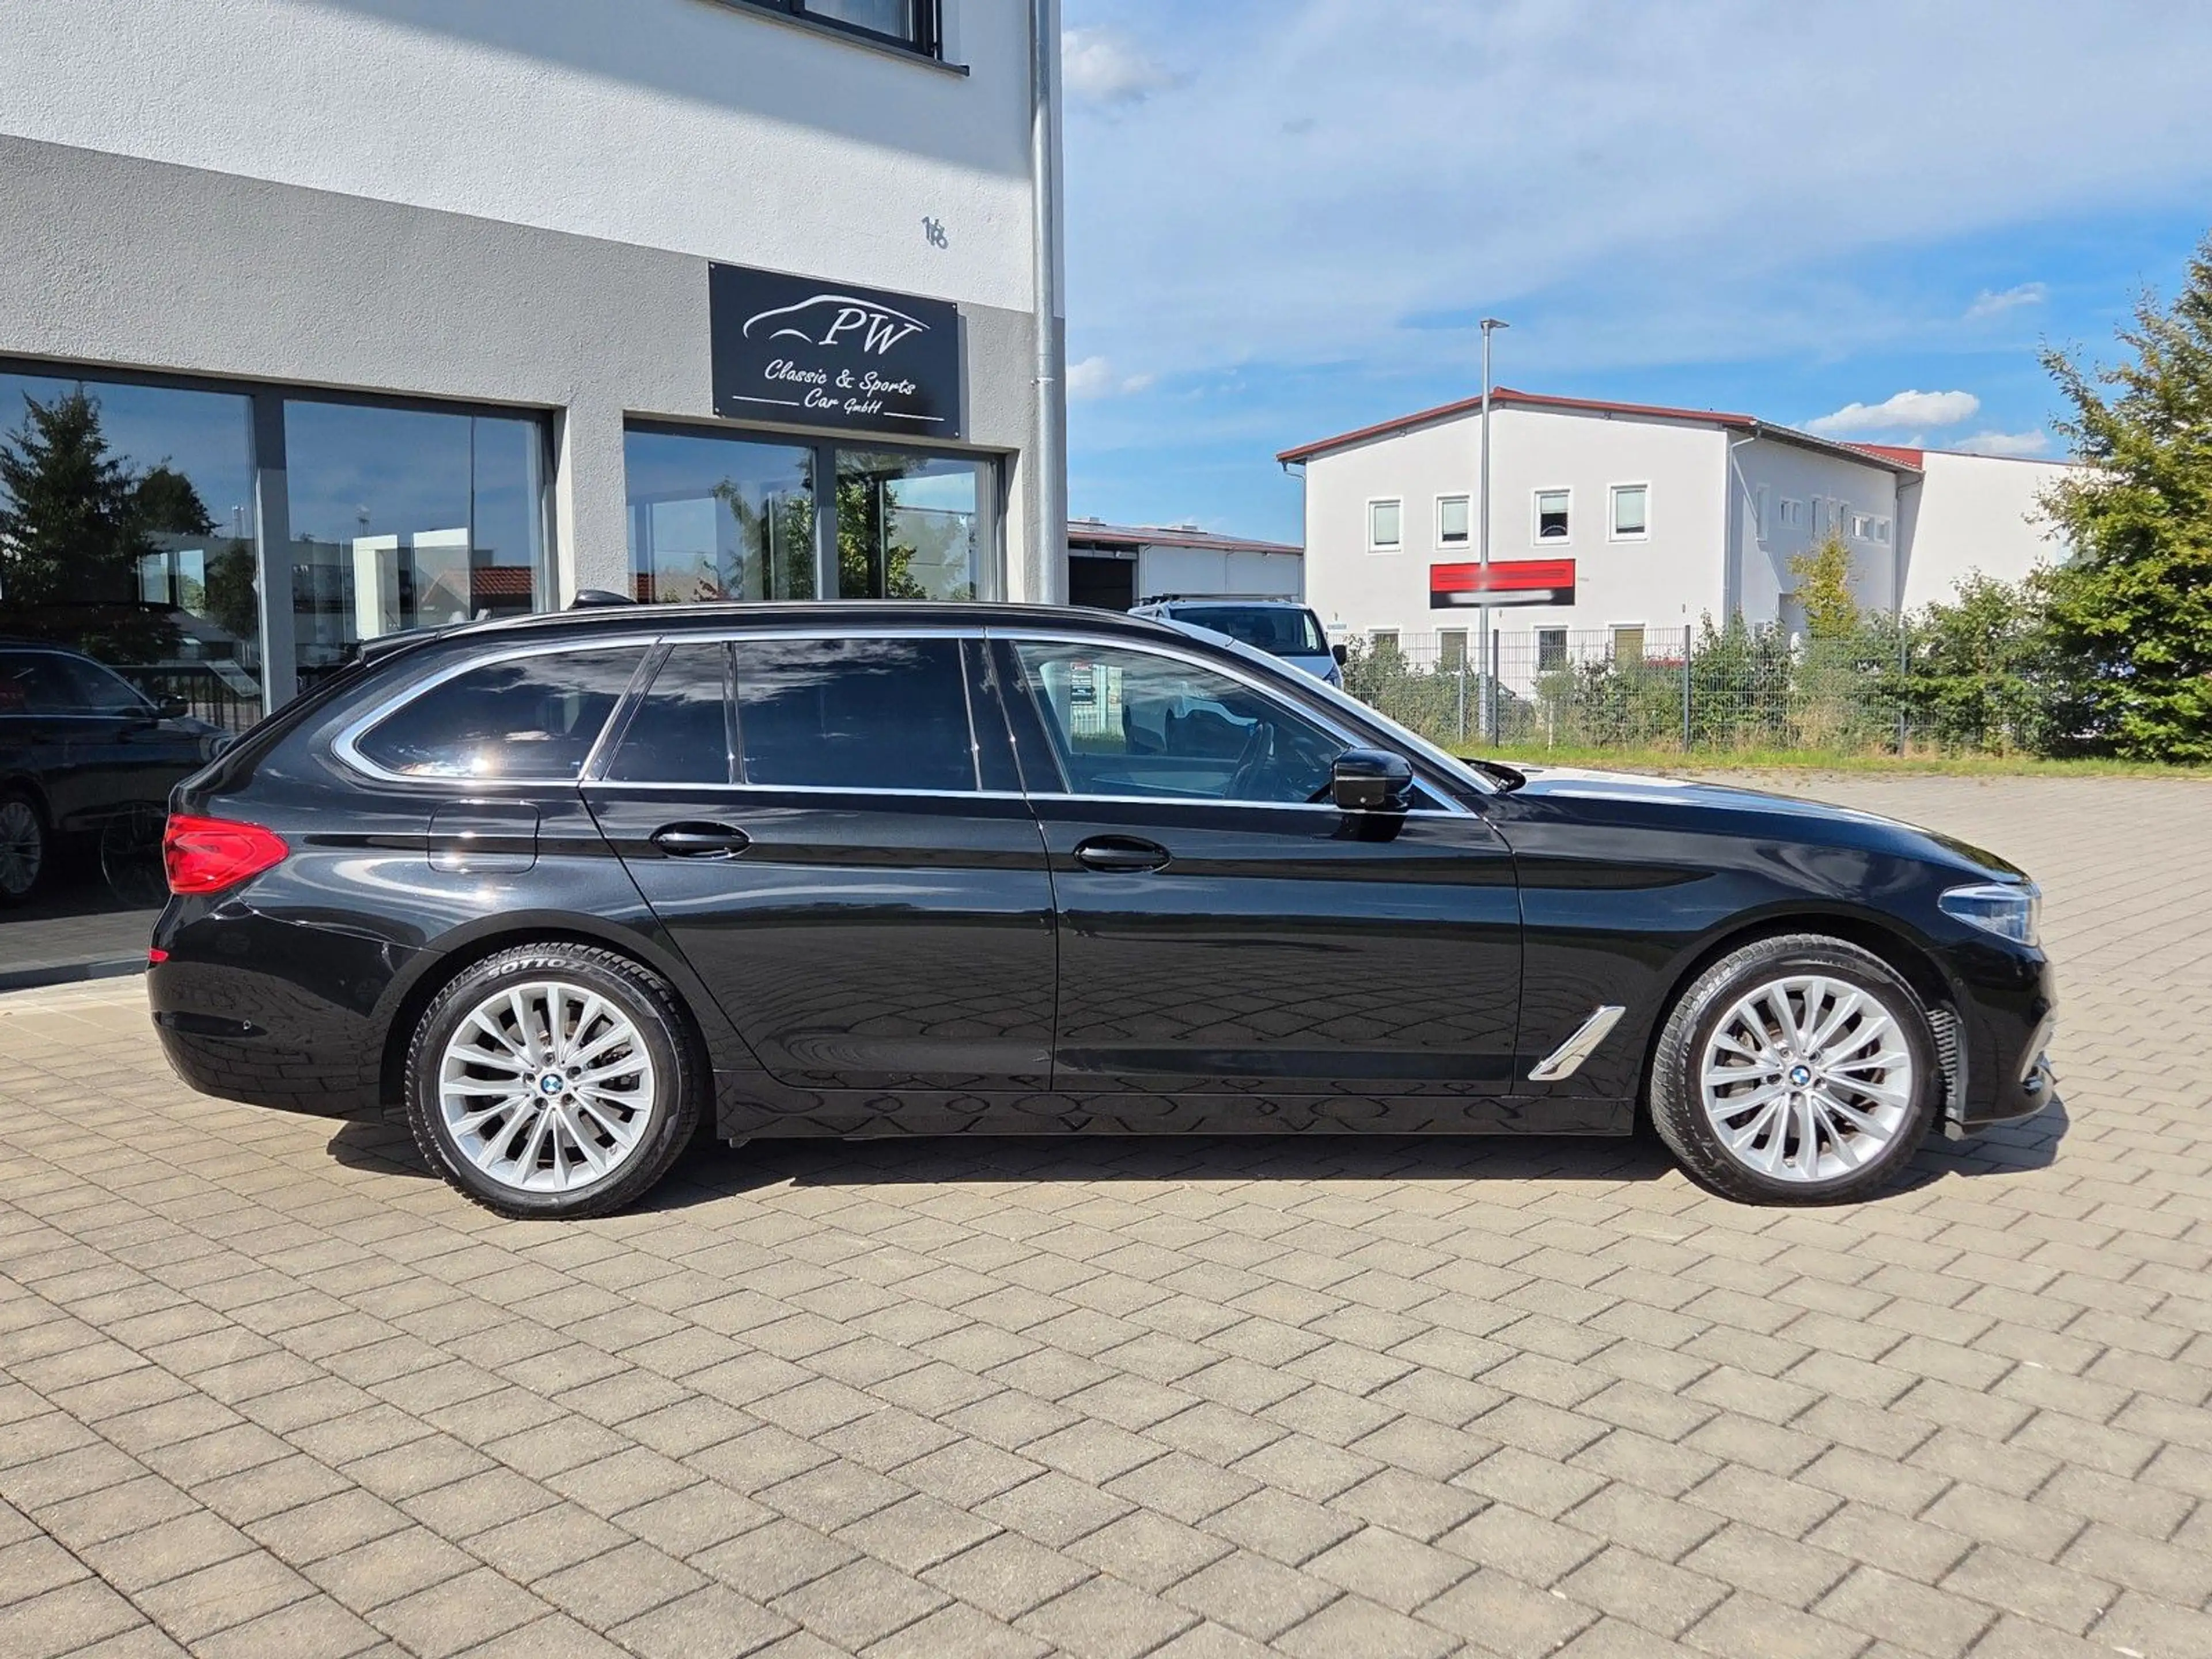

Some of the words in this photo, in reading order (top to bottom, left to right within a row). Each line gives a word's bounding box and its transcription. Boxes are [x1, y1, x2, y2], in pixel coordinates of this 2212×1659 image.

[819, 308, 923, 355] PW
[764, 359, 828, 384] Classic
[836, 369, 855, 388] &
[859, 371, 916, 397] Sports
[804, 387, 838, 408] Car
[844, 398, 883, 415] GmbH
